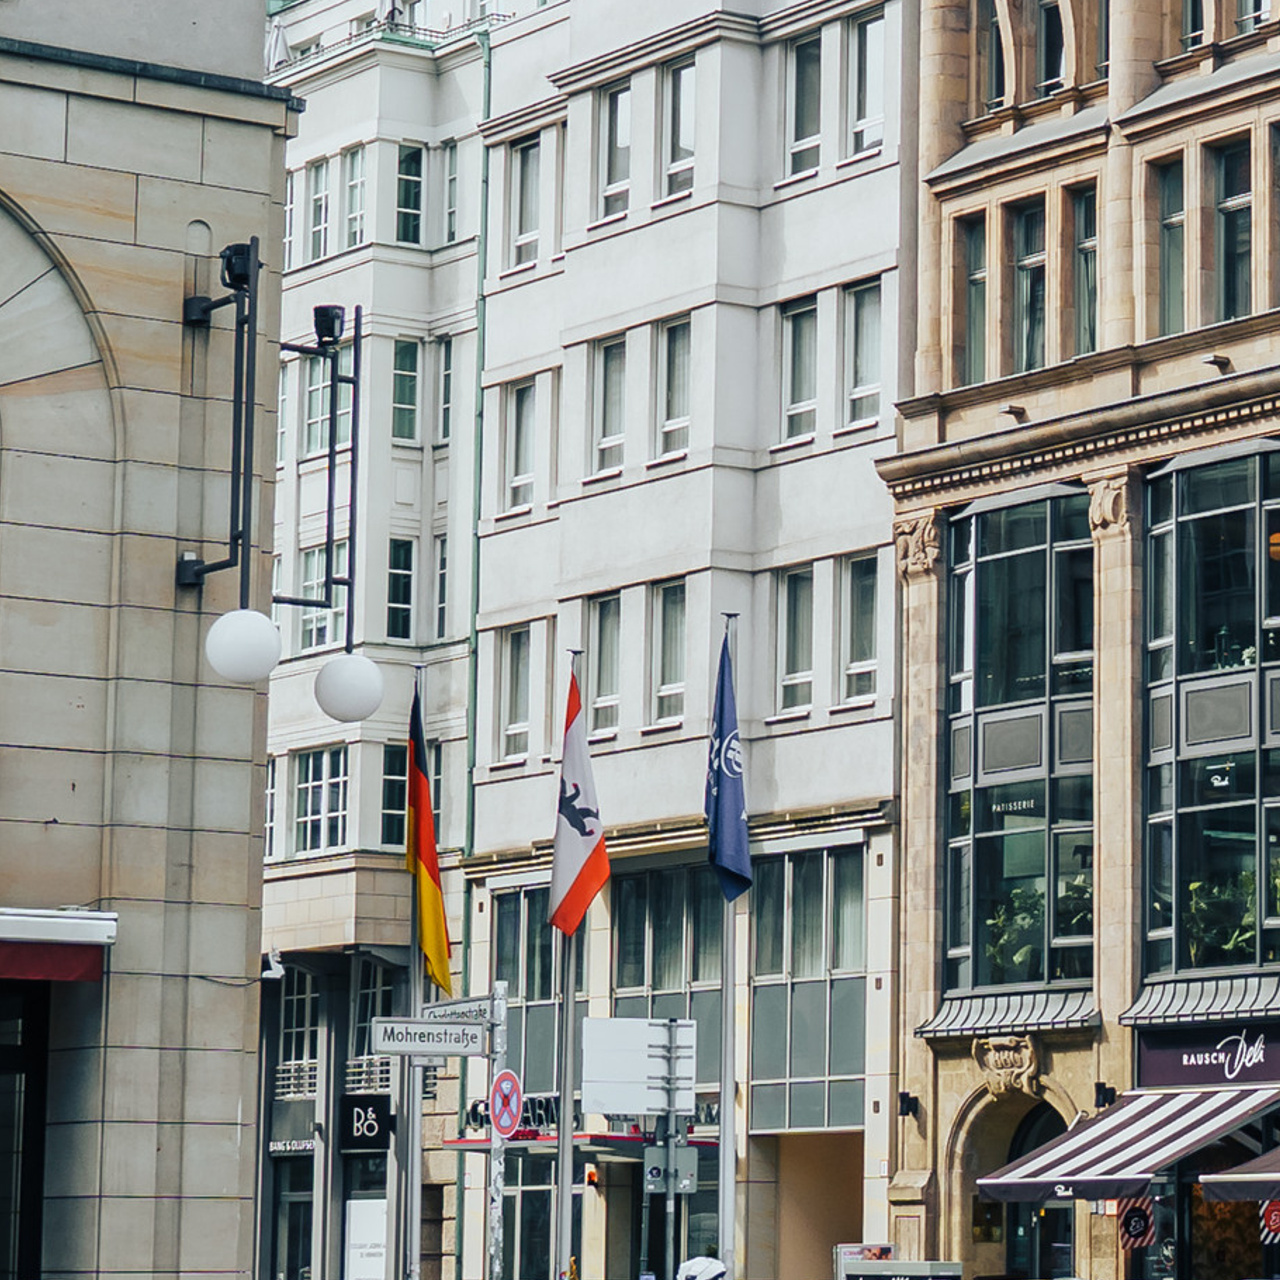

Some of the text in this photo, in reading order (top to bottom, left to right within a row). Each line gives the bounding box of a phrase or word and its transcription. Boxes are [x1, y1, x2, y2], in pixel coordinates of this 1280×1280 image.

[992, 799, 1035, 813] PATISSERIE
[382, 1026, 479, 1048] Mohrenstraße
[1182, 1028, 1266, 1080] RAUSCH Deli
